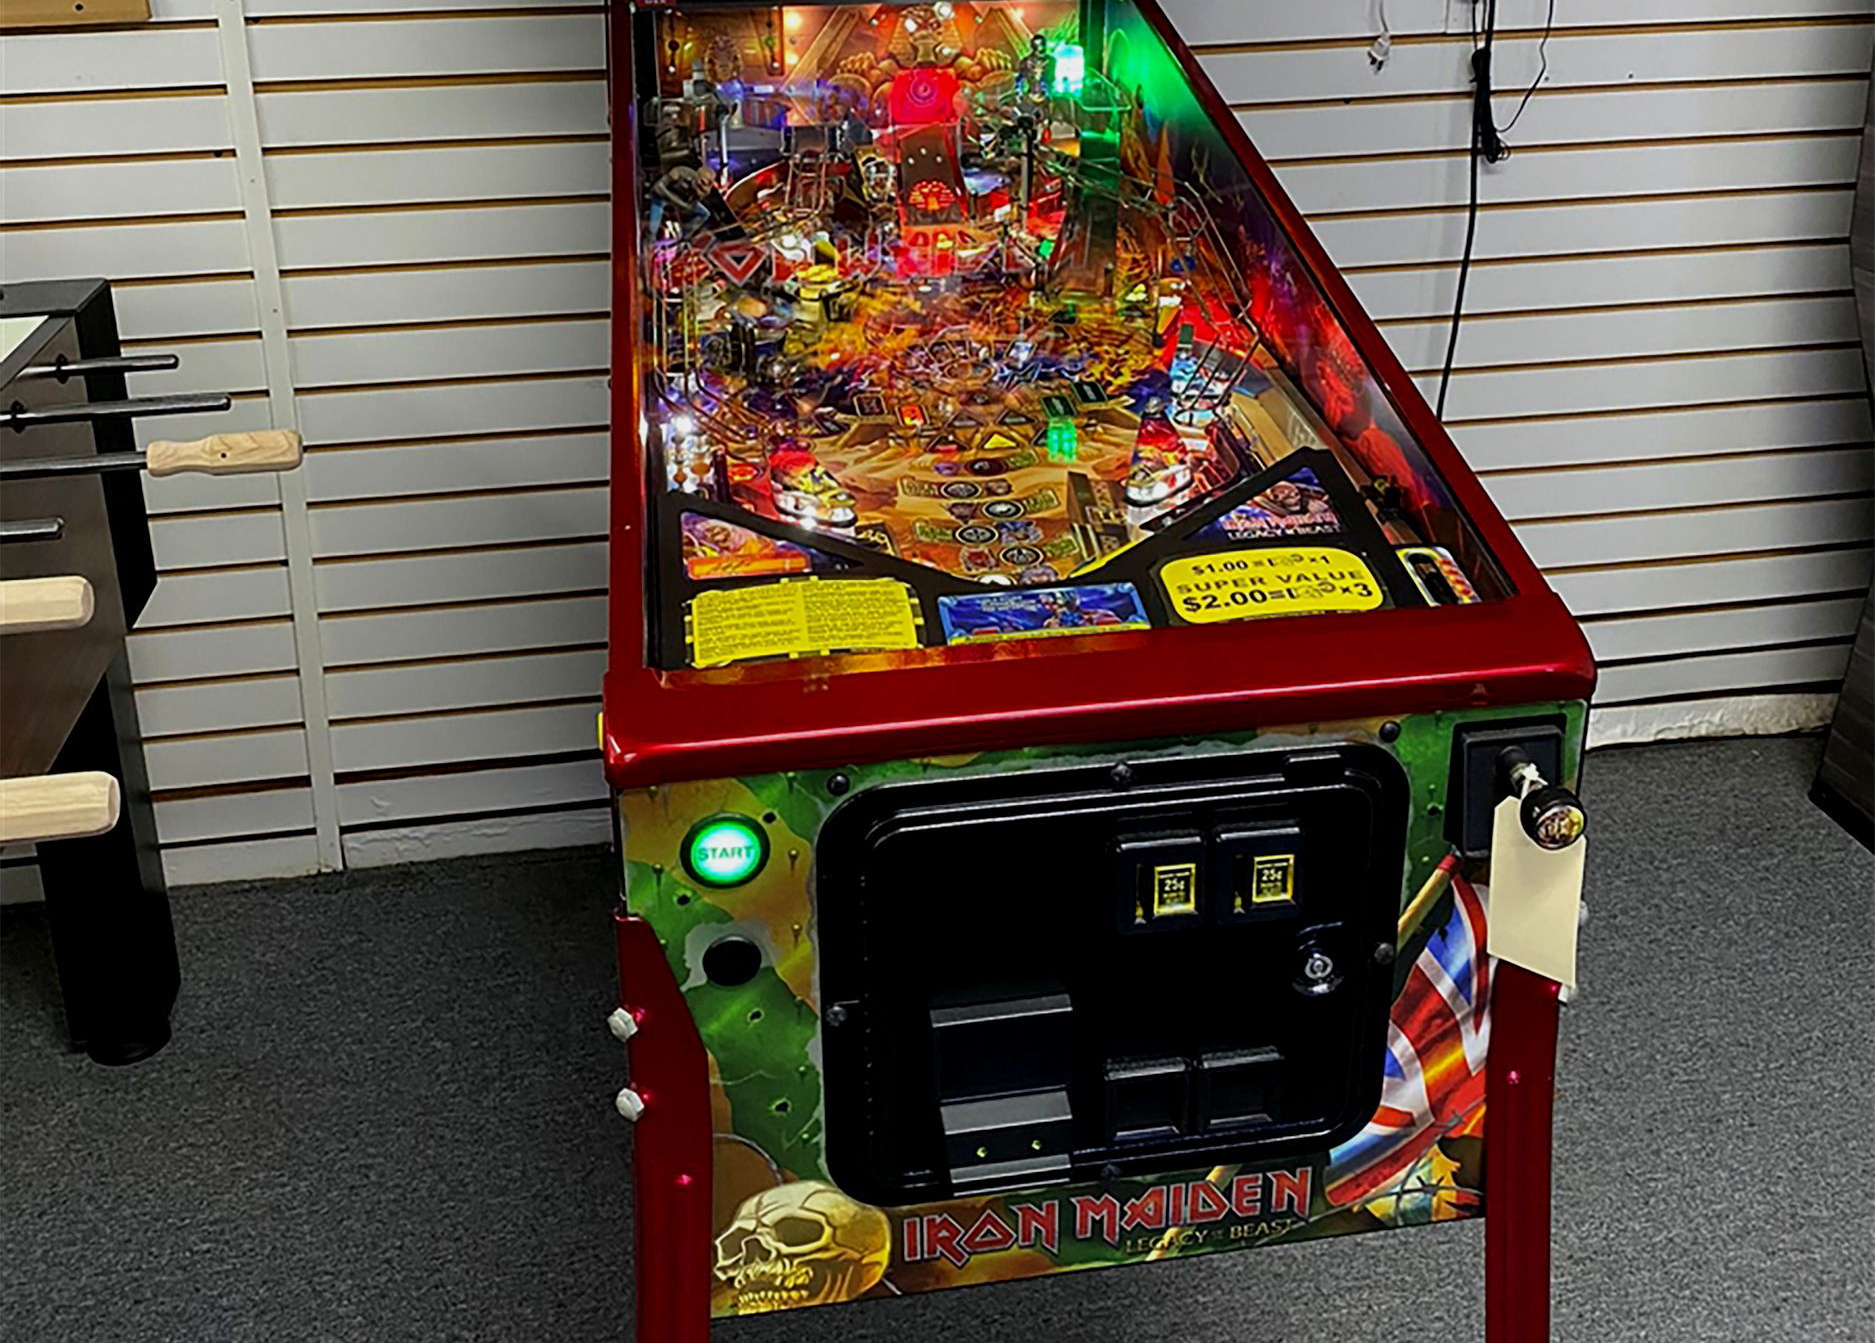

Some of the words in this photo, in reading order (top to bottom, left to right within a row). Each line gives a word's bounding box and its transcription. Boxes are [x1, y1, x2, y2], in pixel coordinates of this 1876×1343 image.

[1191, 559, 1249, 576] $1.00
[1176, 576, 1267, 594] SUPER
[1276, 570, 1365, 584] VALUE
[698, 845, 754, 862] START
[903, 1199, 1060, 1268] IRON
[1070, 1167, 1313, 1248] MAIDEN
[1126, 1230, 1209, 1253] LEGACY
[1230, 1219, 1294, 1240] BEAST
